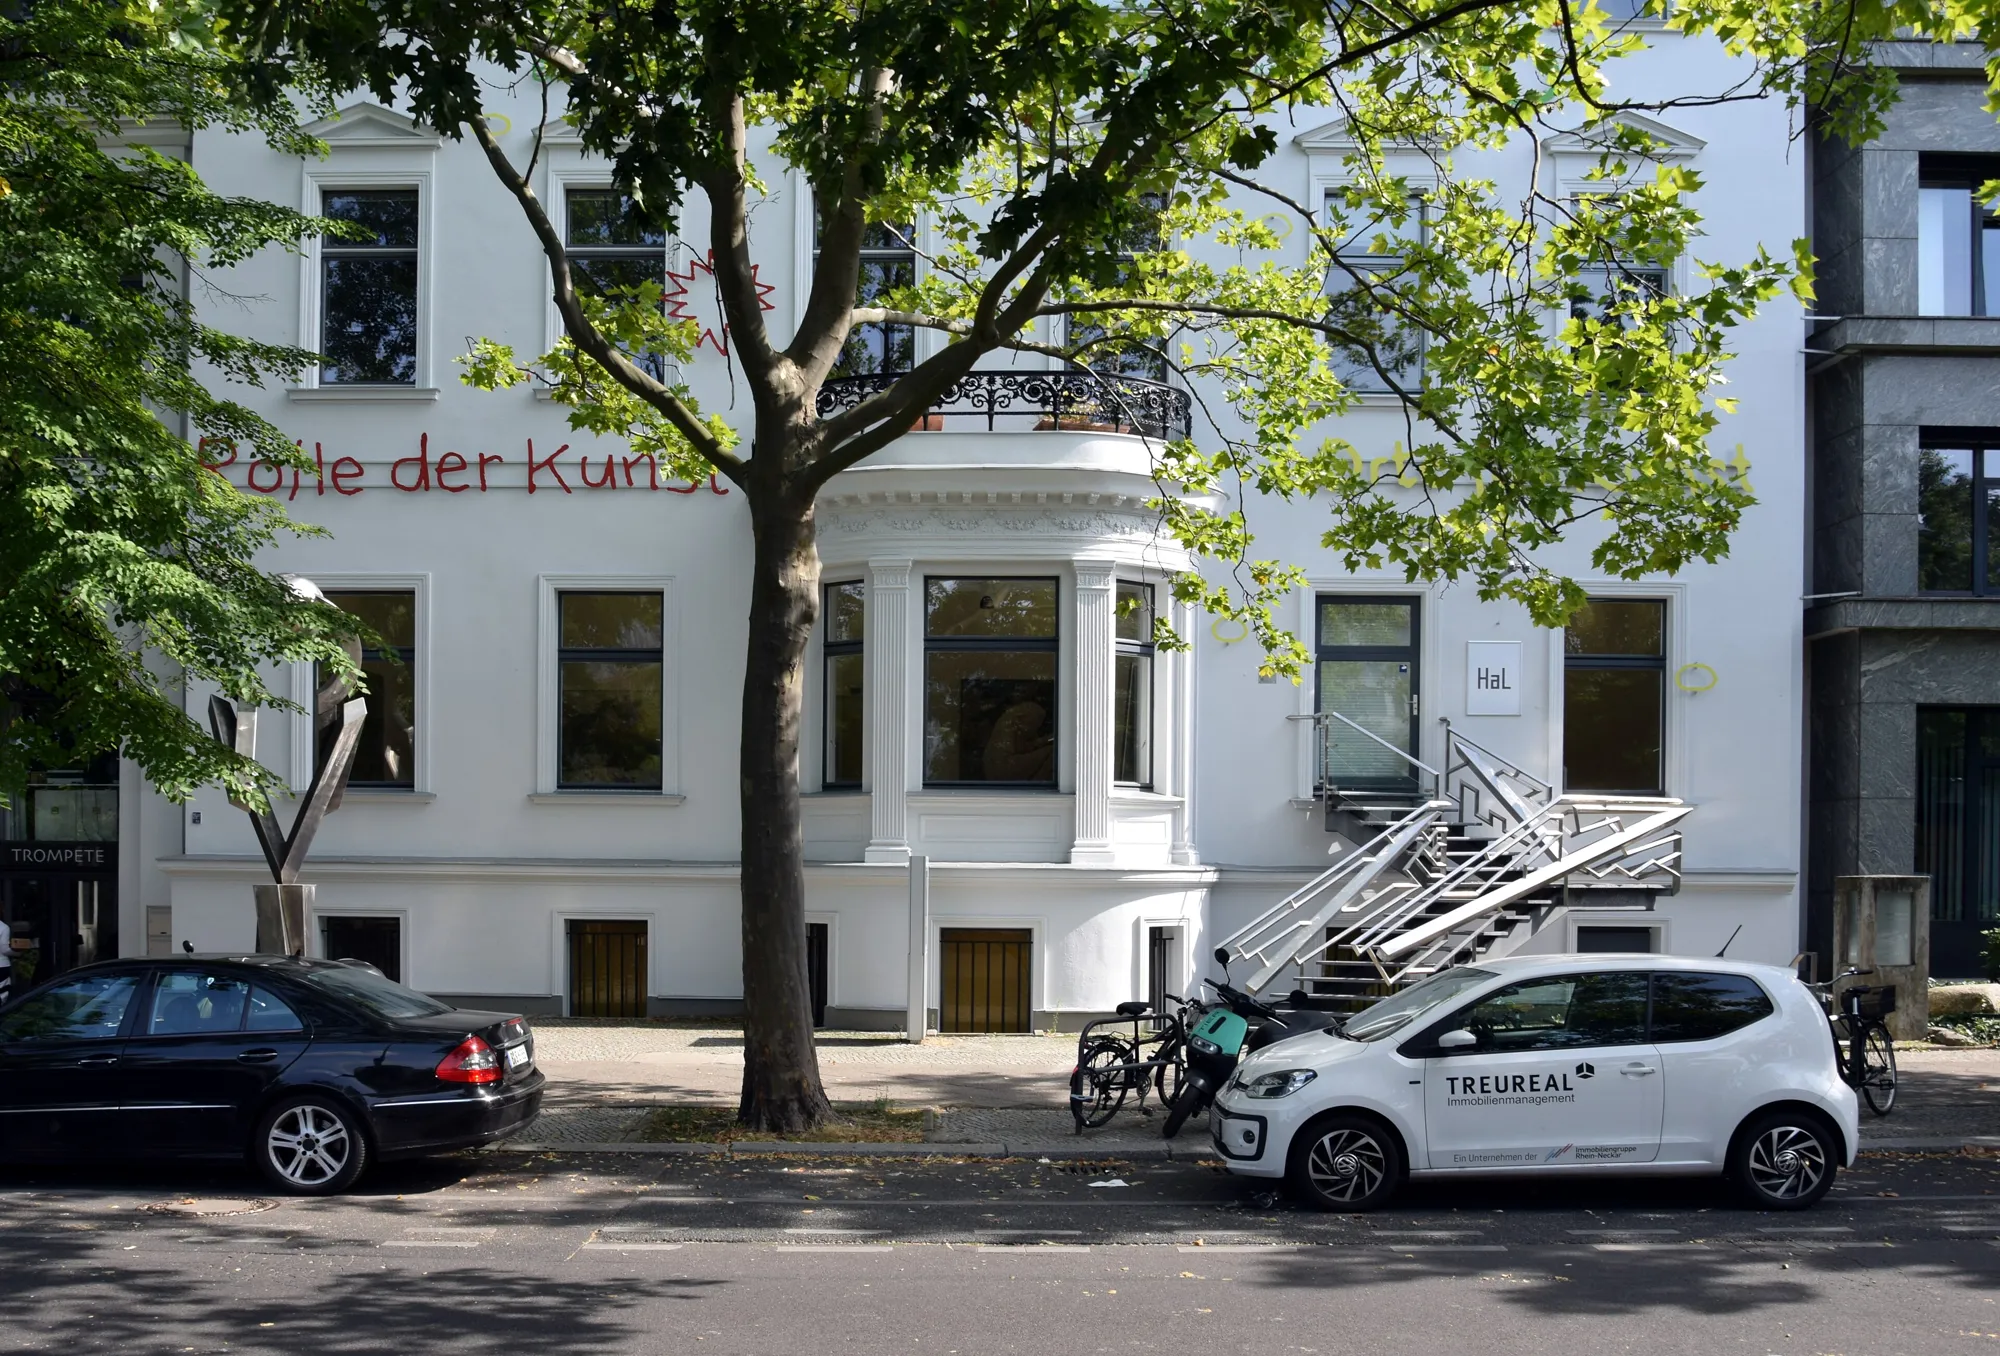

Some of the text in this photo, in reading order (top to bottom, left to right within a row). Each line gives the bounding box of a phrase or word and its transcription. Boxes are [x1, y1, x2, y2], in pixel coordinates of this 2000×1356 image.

[391, 432, 503, 492] der
[1477, 667, 1512, 690] HaL
[11, 848, 105, 863] TROMPETE
[1446, 1073, 1574, 1095] TREUREAL
[1447, 1094, 1575, 1106] Immobilienmanagement
[1575, 1145, 1637, 1154] Immobiliengruppe
[1575, 1152, 1622, 1160] Rhein-Neckar
[1453, 1152, 1538, 1163] Ein Unternehmen der
